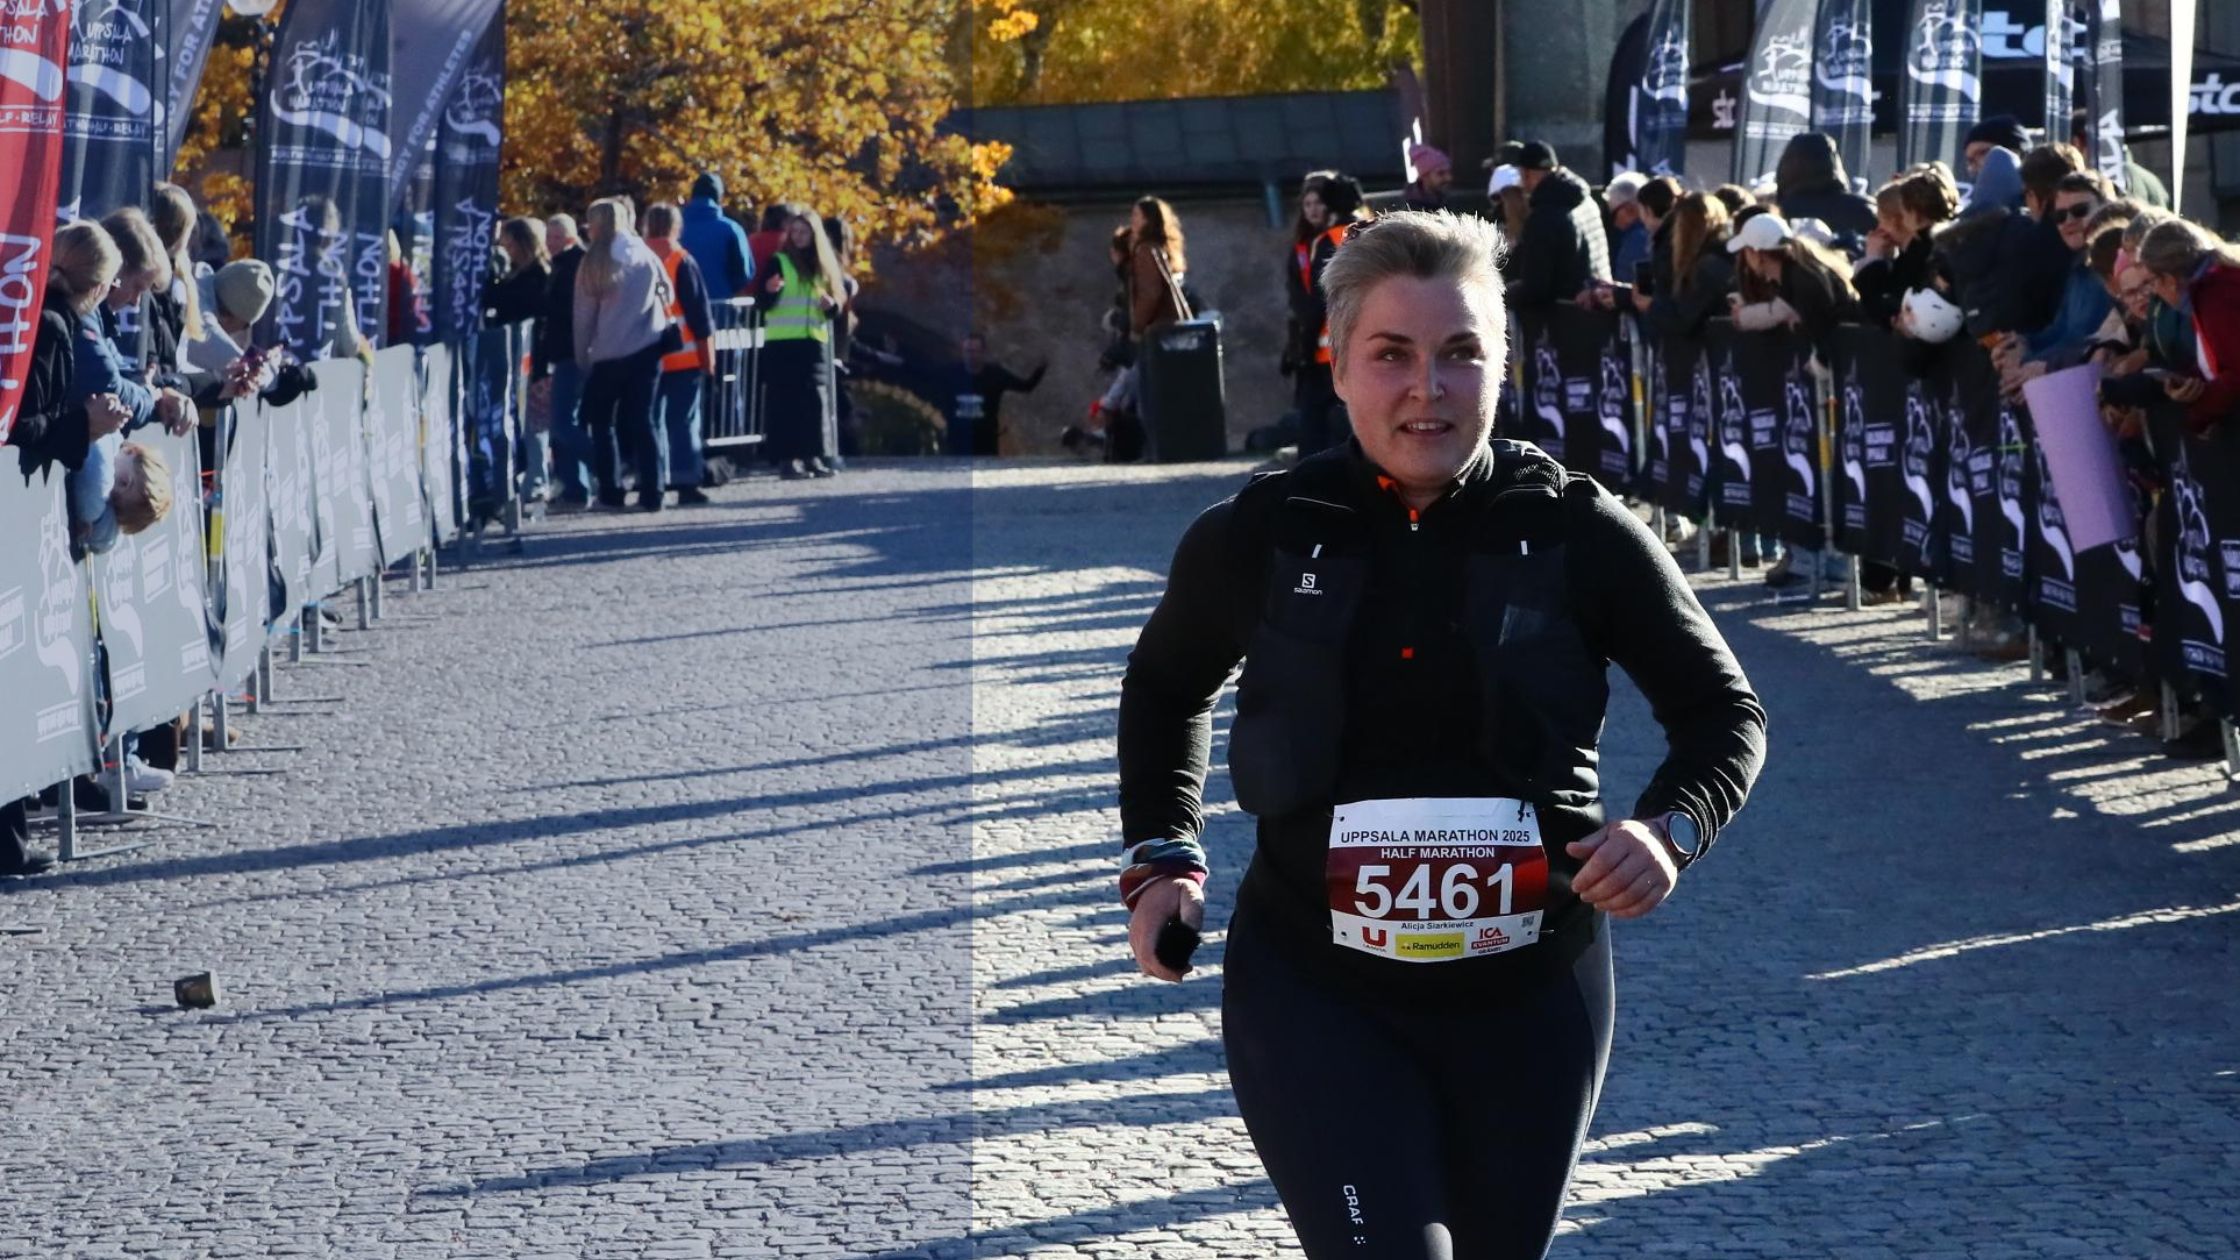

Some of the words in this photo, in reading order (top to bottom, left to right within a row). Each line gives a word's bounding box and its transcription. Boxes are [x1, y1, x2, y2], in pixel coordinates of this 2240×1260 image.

[175, 33, 199, 80] FOR
[407, 110, 430, 145] FOR
[1341, 830, 1408, 844] UPPSALA
[1414, 829, 1499, 842] MARATHON
[1502, 829, 1531, 843] 2025
[1381, 848, 1416, 859] HALF
[1420, 847, 1495, 859] MARATHON
[1354, 863, 1513, 919] 5461
[1401, 922, 1425, 931] Alicja
[1480, 927, 1502, 939] ICA
[1413, 941, 1460, 951] Ramudden
